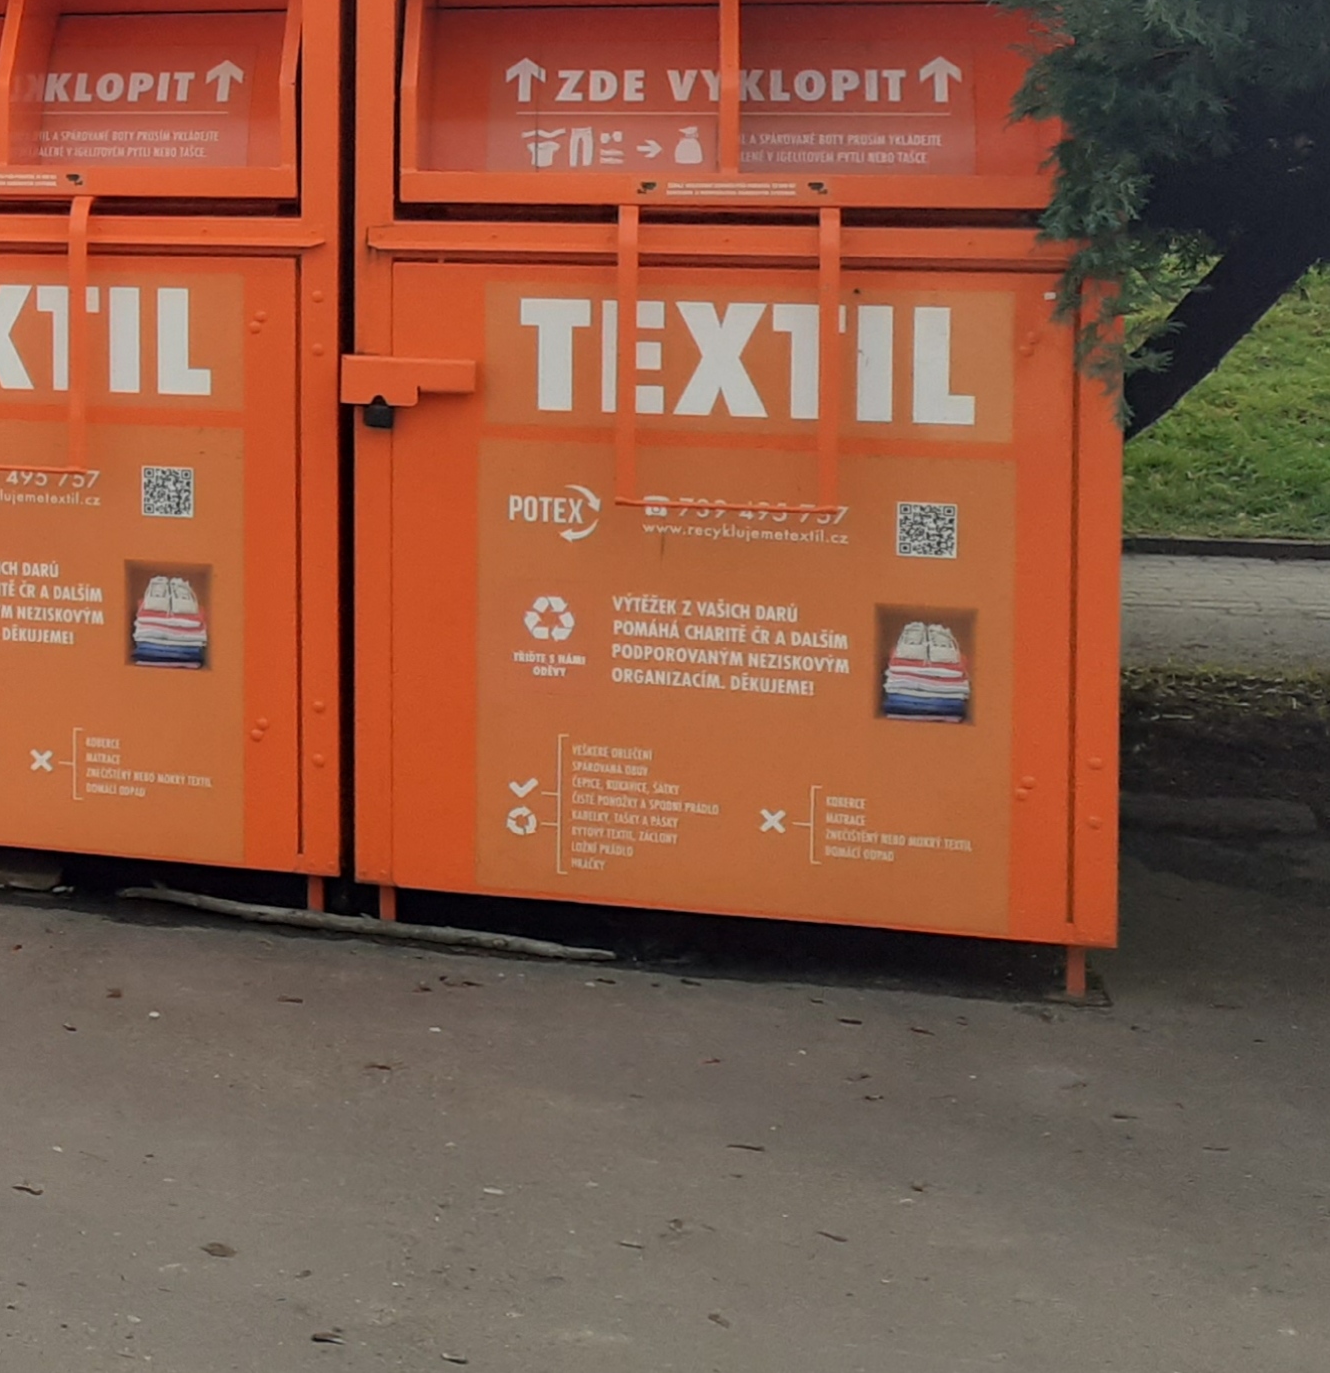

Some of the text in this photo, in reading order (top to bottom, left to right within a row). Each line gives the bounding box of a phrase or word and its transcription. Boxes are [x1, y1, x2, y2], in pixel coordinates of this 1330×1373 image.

[555, 69, 906, 102] ZDE VYKLOPIT
[520, 298, 976, 426] TEXTIL
[509, 494, 584, 524] POTEX
[19, 579, 35, 599] ČR
[40, 585, 49, 599] A
[53, 583, 103, 602] DALŠÍM
[17, 605, 104, 626] NEZISKOVÝM
[612, 593, 677, 615] VÝTĚŽEK
[682, 600, 692, 616] Z
[697, 598, 751, 619] VAŠICH
[2, 624, 75, 645] DĚKUJEME!
[613, 619, 848, 650] POMÁHÁ CHARITĚ ČR A DALŠÍM
[612, 643, 850, 674] PODPOROVANÝM NEZISKOVÝM
[612, 667, 815, 696] ORGANIZACÍM. DĚKUJEME!
